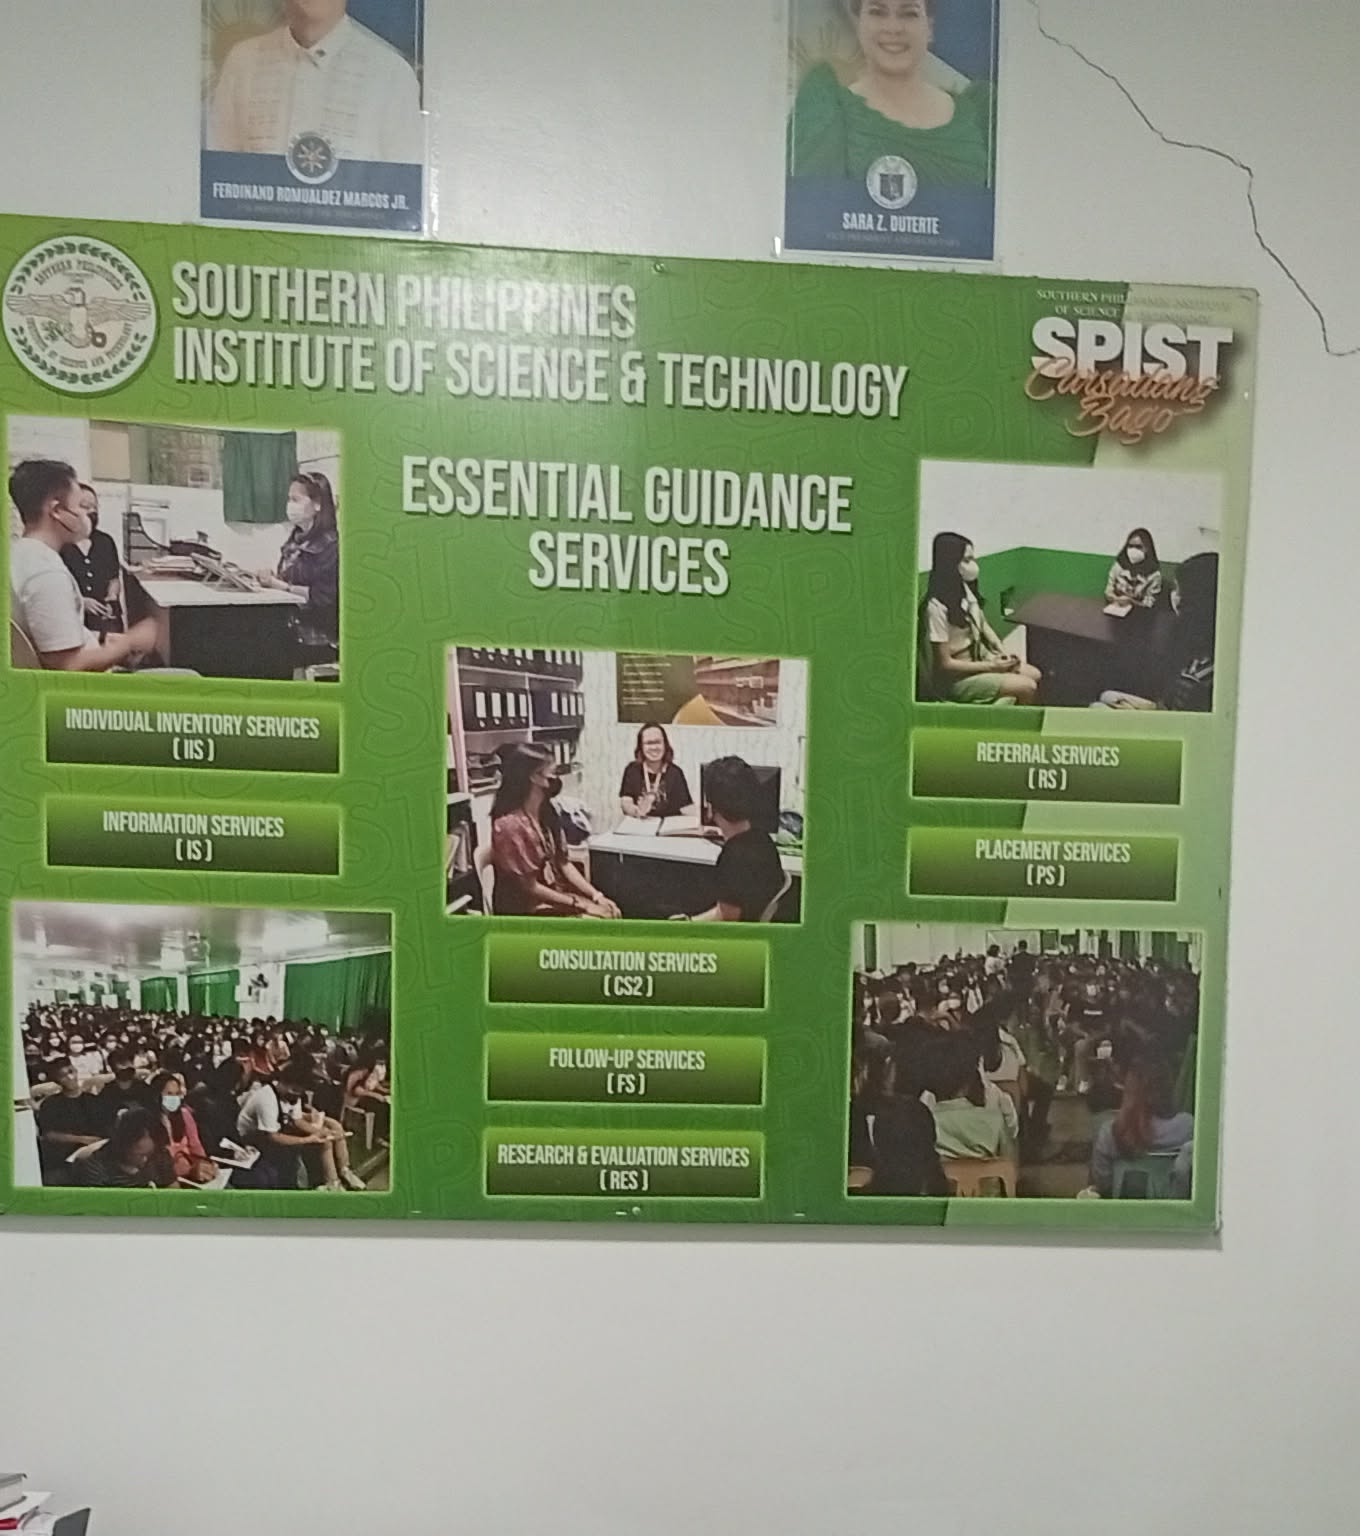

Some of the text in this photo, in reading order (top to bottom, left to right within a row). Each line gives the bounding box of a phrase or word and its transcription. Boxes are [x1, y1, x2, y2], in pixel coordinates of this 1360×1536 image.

[213, 182, 409, 210] FERDINAND ROMUALDEZ MARCOS JR.
[842, 212, 940, 235] SARA Z. DUTERTE
[173, 261, 388, 328] SOUTHERN
[397, 271, 637, 340] PHILIPPINES
[1031, 316, 1234, 386] SPIST
[173, 327, 377, 393] INSTITUTE
[385, 339, 438, 395] OF
[445, 343, 609, 403] SCIENCE
[619, 351, 648, 406] &
[657, 352, 910, 419] TECHNOLOGY
[402, 454, 854, 534] ESSENTIAL GUIDANCE
[529, 530, 732, 596] SERVICES
[65, 707, 320, 739] INDIVIDUAL INVENTORY SERVICES
[976, 742, 1120, 767] REFERRAL SERVICES
[103, 810, 284, 838] INFORMATION SERVICES
[975, 838, 1131, 863] PLACEMENT SERVICES
[539, 949, 718, 974] CONSULTATION SERVICES
[549, 1048, 706, 1071] FOLLOW-UP SERVICES
[497, 1143, 750, 1168] RESEARCH & EVALUATION SERVICES
